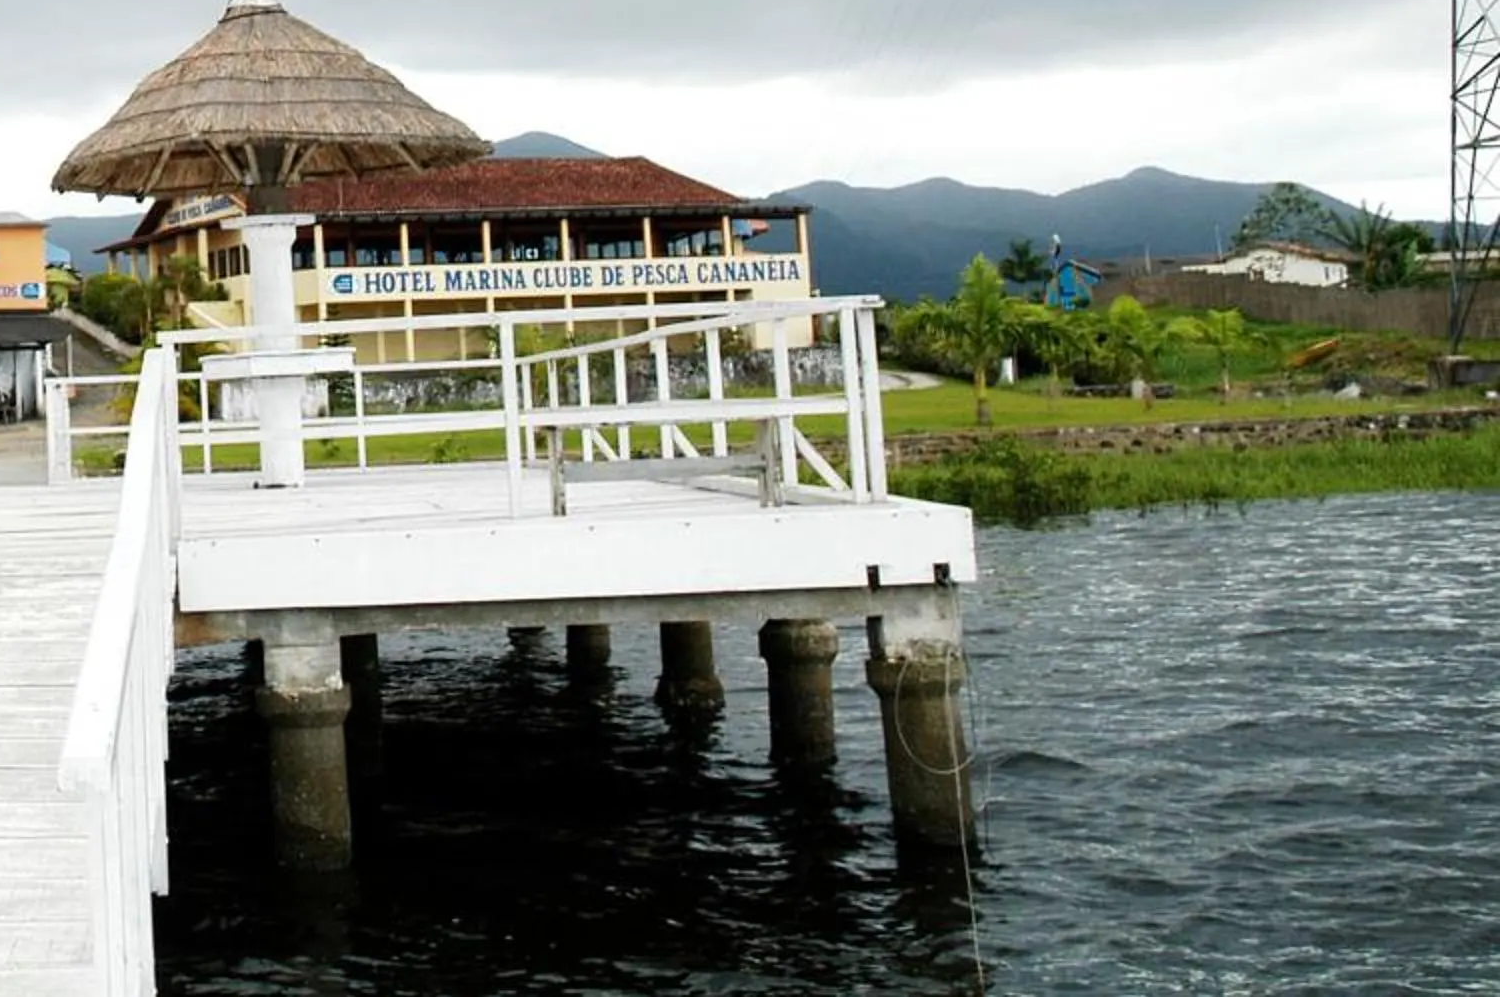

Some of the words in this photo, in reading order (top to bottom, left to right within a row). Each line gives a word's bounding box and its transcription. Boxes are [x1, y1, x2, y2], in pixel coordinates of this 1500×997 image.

[364, 271, 436, 293] HOTEL
[444, 268, 527, 292] MARINA
[533, 266, 593, 289] CLUBE
[601, 264, 625, 287] DE
[633, 263, 689, 286] PESCA
[697, 257, 801, 284] CANANÉIA
